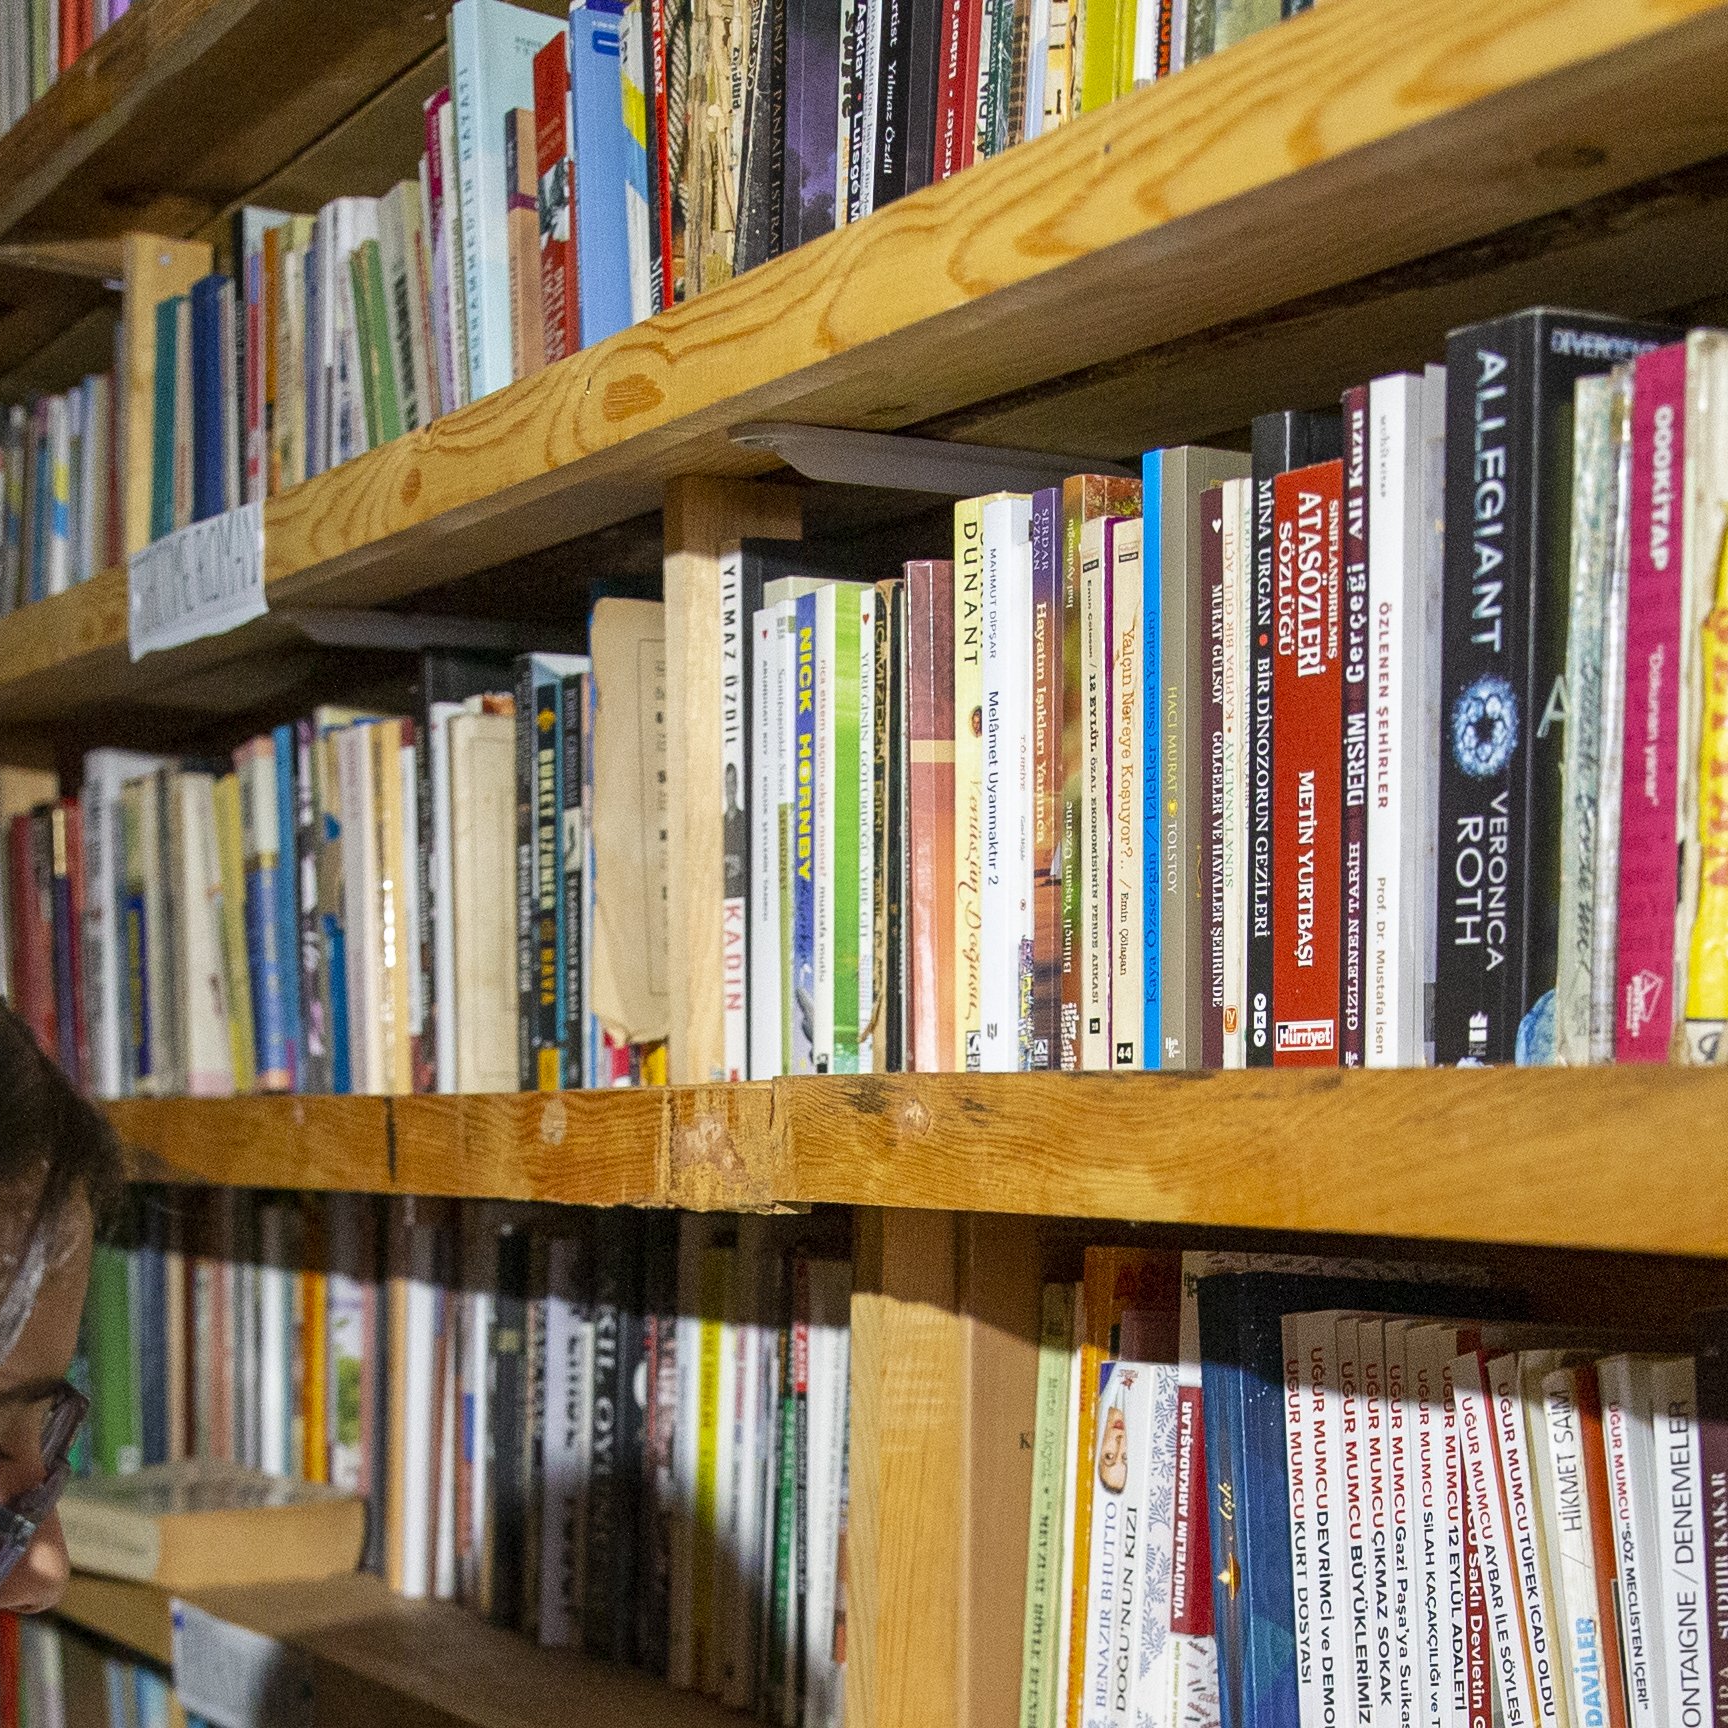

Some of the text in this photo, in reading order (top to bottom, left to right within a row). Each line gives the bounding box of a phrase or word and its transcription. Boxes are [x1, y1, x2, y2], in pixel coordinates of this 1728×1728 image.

[1042, 508, 1050, 571] SERDAR
[1470, 349, 1508, 654] ALLEGIANT
[963, 521, 978, 667] DUNANT
[1035, 602, 1047, 682] Hayatın
[1276, 520, 1294, 656] SÖZLÜĞÜ
[1297, 490, 1326, 680] ATASÖZLERİ
[1326, 498, 1340, 659] SINIFLANDIRILMIŞ
[1120, 693, 1135, 752] Nereye
[1121, 626, 1135, 686] Yalçın
[1253, 479, 1273, 940] MİNA URGAN BİR DİNOZORUN GEZİLERİ
[1345, 409, 1368, 1031] GİZLENEN TARİH DERSİM Gerçeği Ali Kuzu
[1376, 602, 1390, 808] ÖZLENEN ŞEHİRLER
[798, 628, 813, 882] NICK HORNBY
[987, 690, 1000, 886] Melâmet Uyanmaktır 2
[1167, 686, 1179, 895] HACI MURAT TOLSTOY
[1210, 584, 1223, 1008] MURAT GÜLSOY GÖLGELER VE HAYALLER ŞEHRİNDE
[1294, 770, 1317, 969] METİN YURTBAŞI
[1375, 877, 1386, 915] Prof.
[1375, 920, 1386, 945] Dr.
[1455, 814, 1484, 947] ROTH
[1485, 790, 1509, 974] VERONICA
[725, 903, 743, 1011] KADIN
[1375, 949, 1386, 1015] Mustafa
[1278, 1024, 1330, 1047] Hürriyet
[1310, 1346, 1325, 1413] UĞUR
[1173, 1400, 1194, 1621] YÜRÜYELİM ARKADAŞLAR
[1286, 1358, 1313, 1685] UĞUR MUMCU KURT DOSYASI
[1313, 1420, 1328, 1510] MUMCU
[1558, 1452, 1584, 1533] HİKMET
[1669, 1400, 1695, 1566] DENEMELER
[1712, 1470, 1728, 1549] KAKAR
[1316, 1511, 1335, 1620] DEVRİMCİ
[1342, 1362, 1374, 1725] UĞUR MUMCU BÜYÜKLERİMİZ
[1369, 1437, 1392, 1706] MUMCU ÇIKMAZ SOKAK
[1394, 1526, 1409, 1571] Gazi
[1423, 1512, 1435, 1565] SİLAH
[1462, 1396, 1523, 1728] UĞUR MUMCU AYBAR İLE SÖYLEŞİ
[1467, 1552, 1483, 1608] Saklı
[1498, 1383, 1555, 1717] UĞUR MUMCU TÜFEK İCAD OLDU
[1620, 1523, 1636, 1563] "SÖZ
[1095, 1502, 1117, 1709] BENAZIR BHUTTO
[1116, 1507, 1138, 1712] DOĞU'NUN KIZI
[1319, 1626, 1330, 1650] ve
[1397, 1578, 1412, 1659] Paşa'ya
[1425, 1571, 1441, 1687] KAÇAKÇILIĞI
[1449, 1525, 1468, 1712] 12 EYLÜL ADALETİ
[1470, 1614, 1485, 1709] Devletin
[1624, 1567, 1644, 1657] MECLİSTEN
[1429, 1689, 1439, 1712] ve
